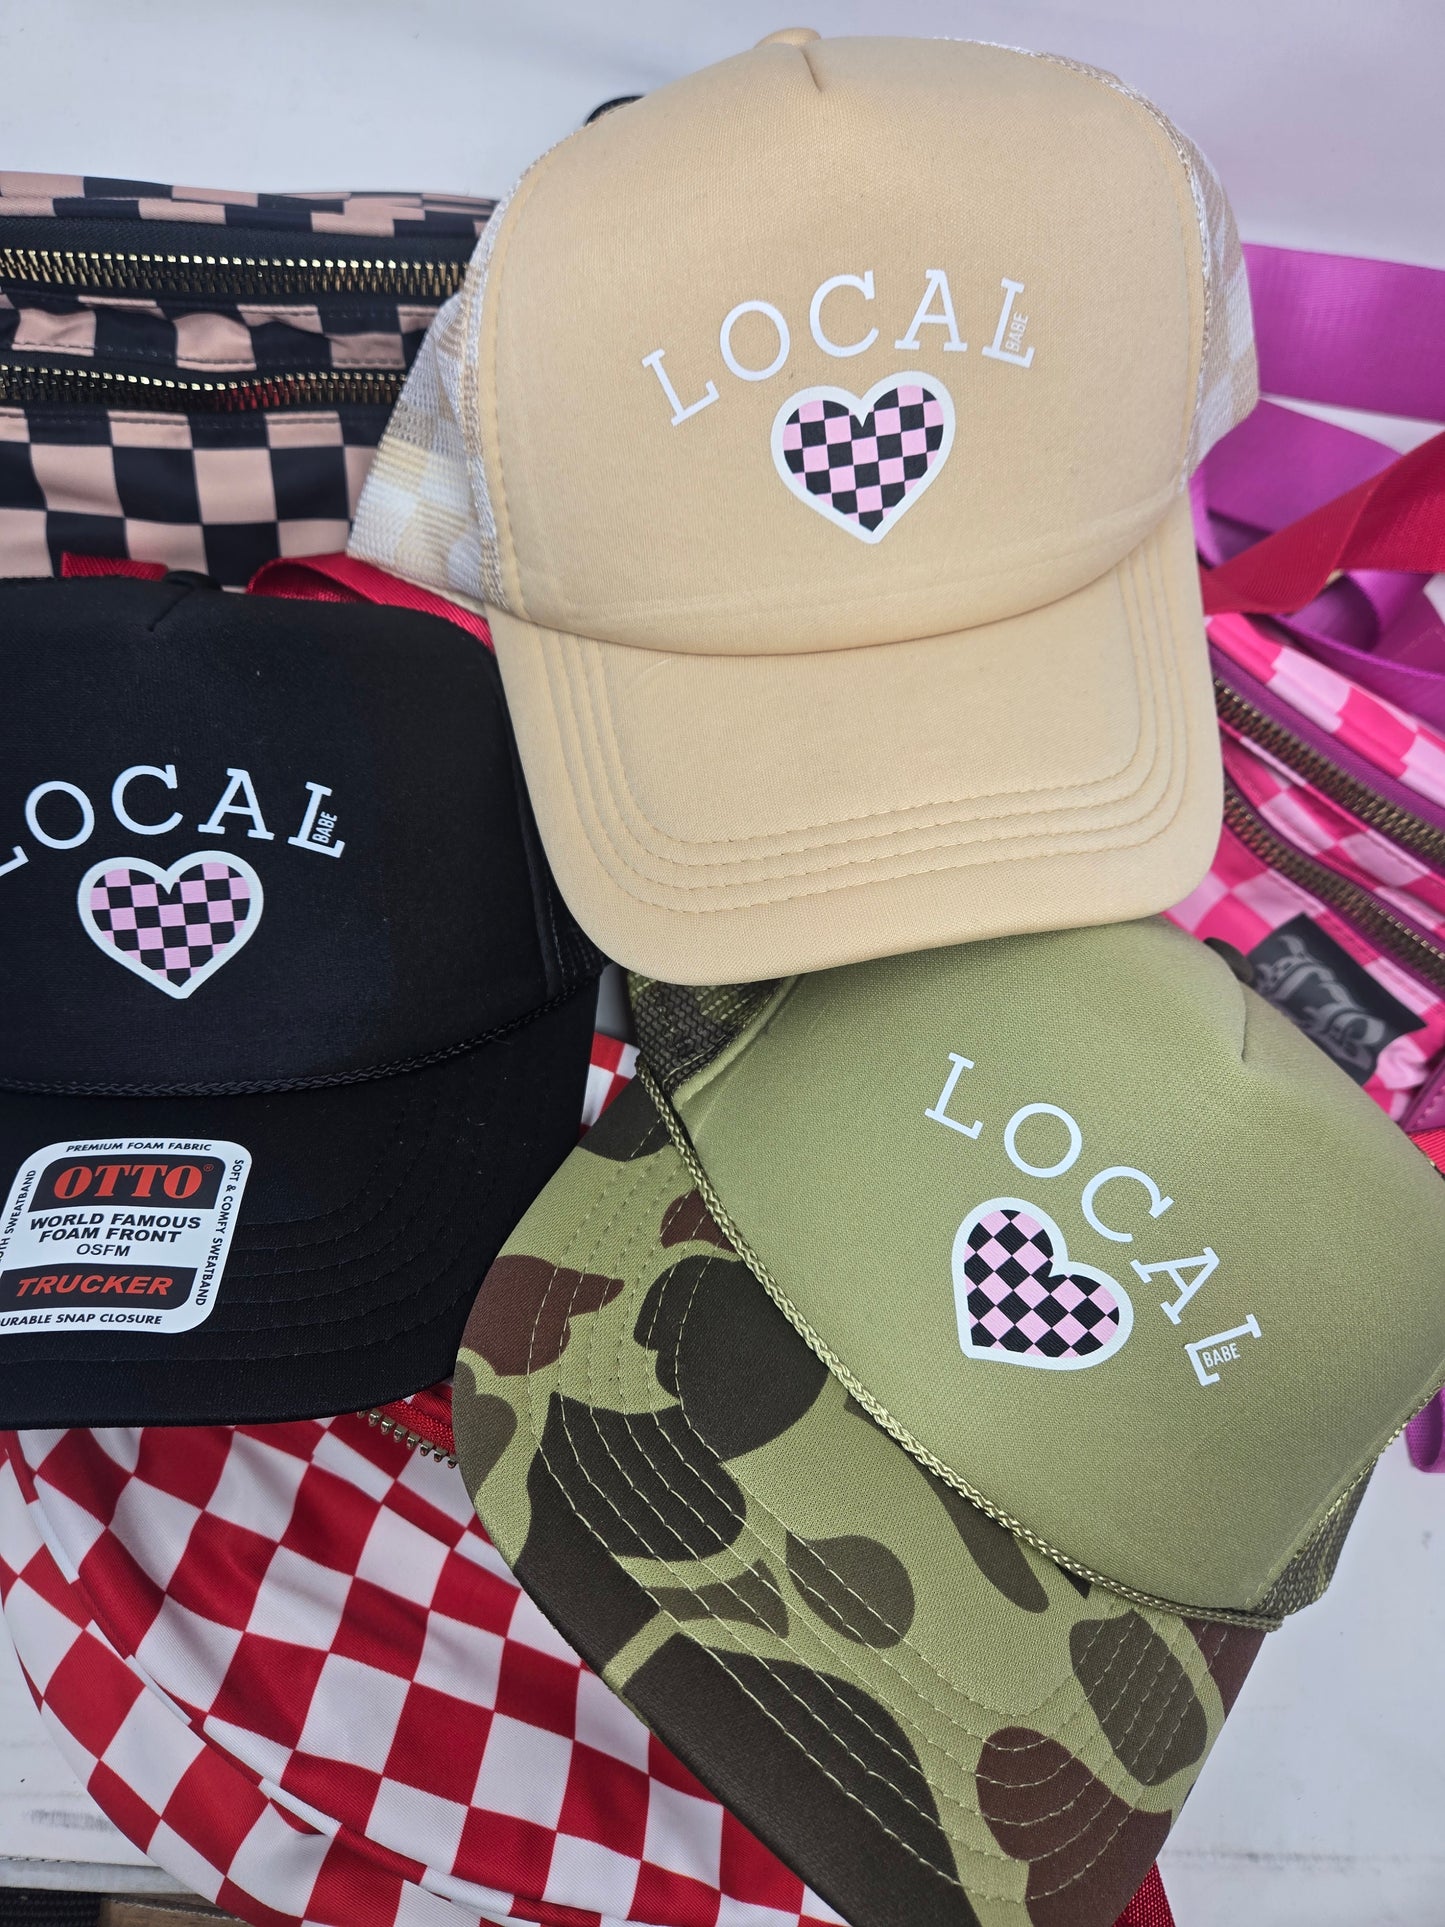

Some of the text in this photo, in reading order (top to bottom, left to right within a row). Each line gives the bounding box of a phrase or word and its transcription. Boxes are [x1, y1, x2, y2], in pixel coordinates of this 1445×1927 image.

[1004, 311, 1029, 353] BABE
[642, 269, 1036, 427] LOCAL
[311, 810, 338, 844] BABE
[66, 1142, 212, 1153] PREMIUM FOAM FABRIC
[4, 1169, 37, 1235] SWEATBAND
[30, 1213, 201, 1231] WORLD FAMOUS
[924, 1051, 1262, 1387] LOCAL
[38, 1227, 182, 1243] FOAM FRONT
[195, 1159, 244, 1306] SOFT & COMFY SWEATBAND
[76, 1243, 131, 1257] OSFM
[16, 1274, 174, 1297] TRUCKER
[0, 1313, 163, 1327] URABLE SNAP CLOSURE
[1202, 1342, 1241, 1368] BABE
